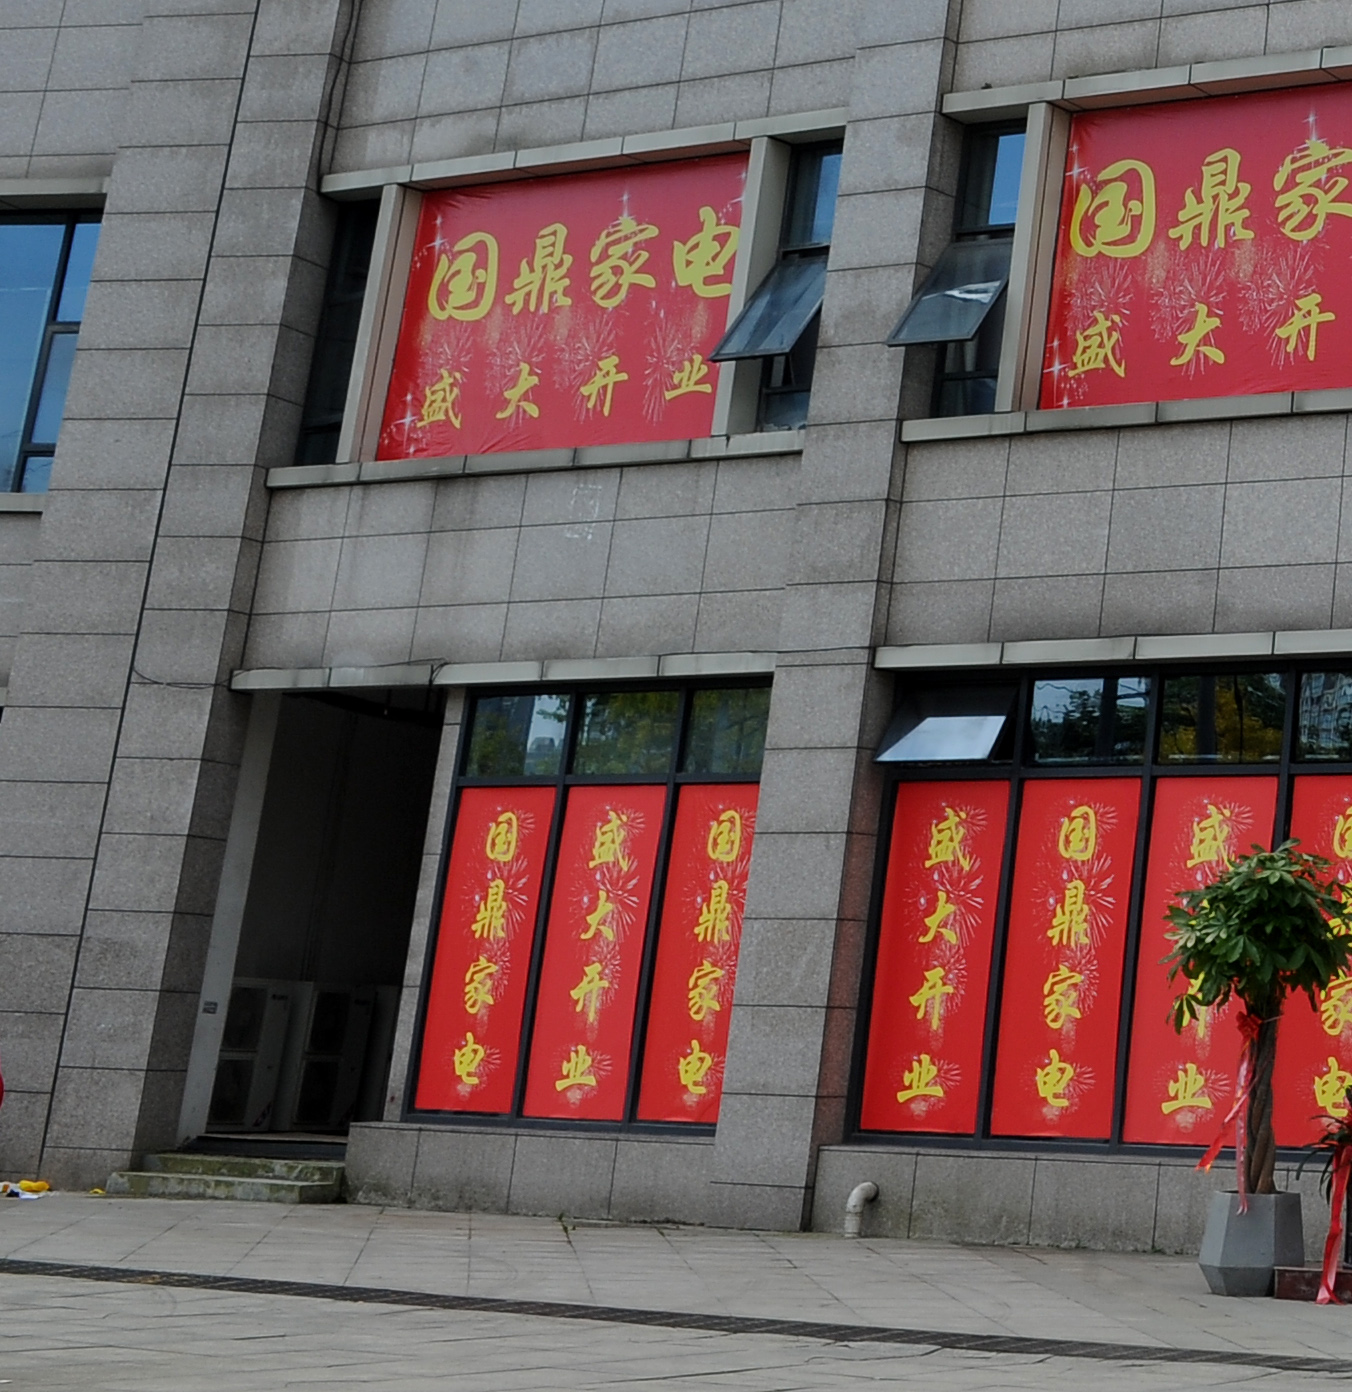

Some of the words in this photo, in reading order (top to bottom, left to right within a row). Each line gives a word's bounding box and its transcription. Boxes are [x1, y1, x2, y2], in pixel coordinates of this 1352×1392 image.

[416, 354, 714, 430] 盛大开业
[428, 206, 741, 321] 国鼎家电
[453, 810, 520, 1086] 国鼎家电
[555, 810, 629, 1093] 盛大开业
[678, 809, 742, 1096] 国鼎家电
[896, 807, 972, 1104] 盛大开业
[1035, 805, 1097, 1107] 国鼎家电
